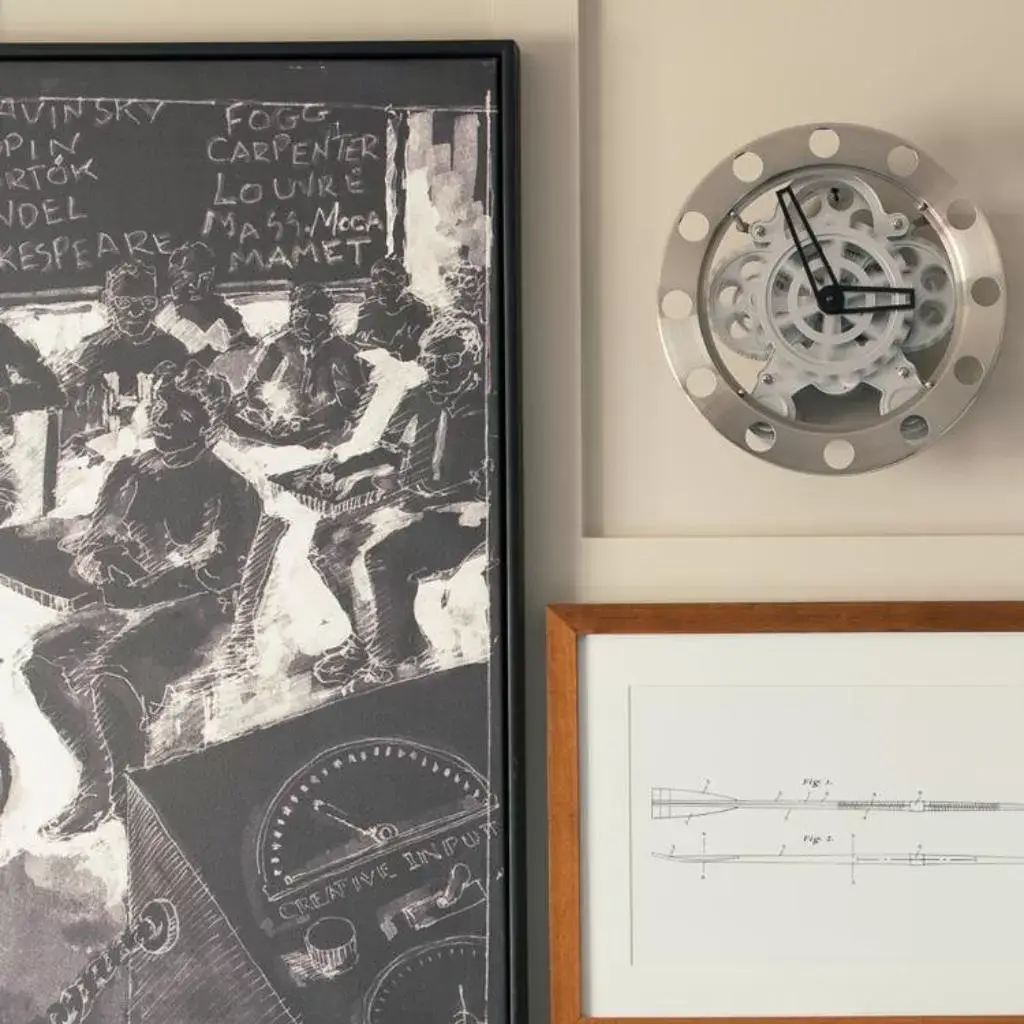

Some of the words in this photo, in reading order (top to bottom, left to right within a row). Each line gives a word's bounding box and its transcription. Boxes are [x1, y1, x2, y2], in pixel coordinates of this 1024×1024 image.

[225, 101, 329, 135] FOGG
[0, 132, 81, 161] PIN
[207, 122, 382, 166] CARPENTER
[228, 238, 372, 273] MAMET
[279, 862, 398, 921] CREATIVE
[402, 821, 500, 872] INPUT
